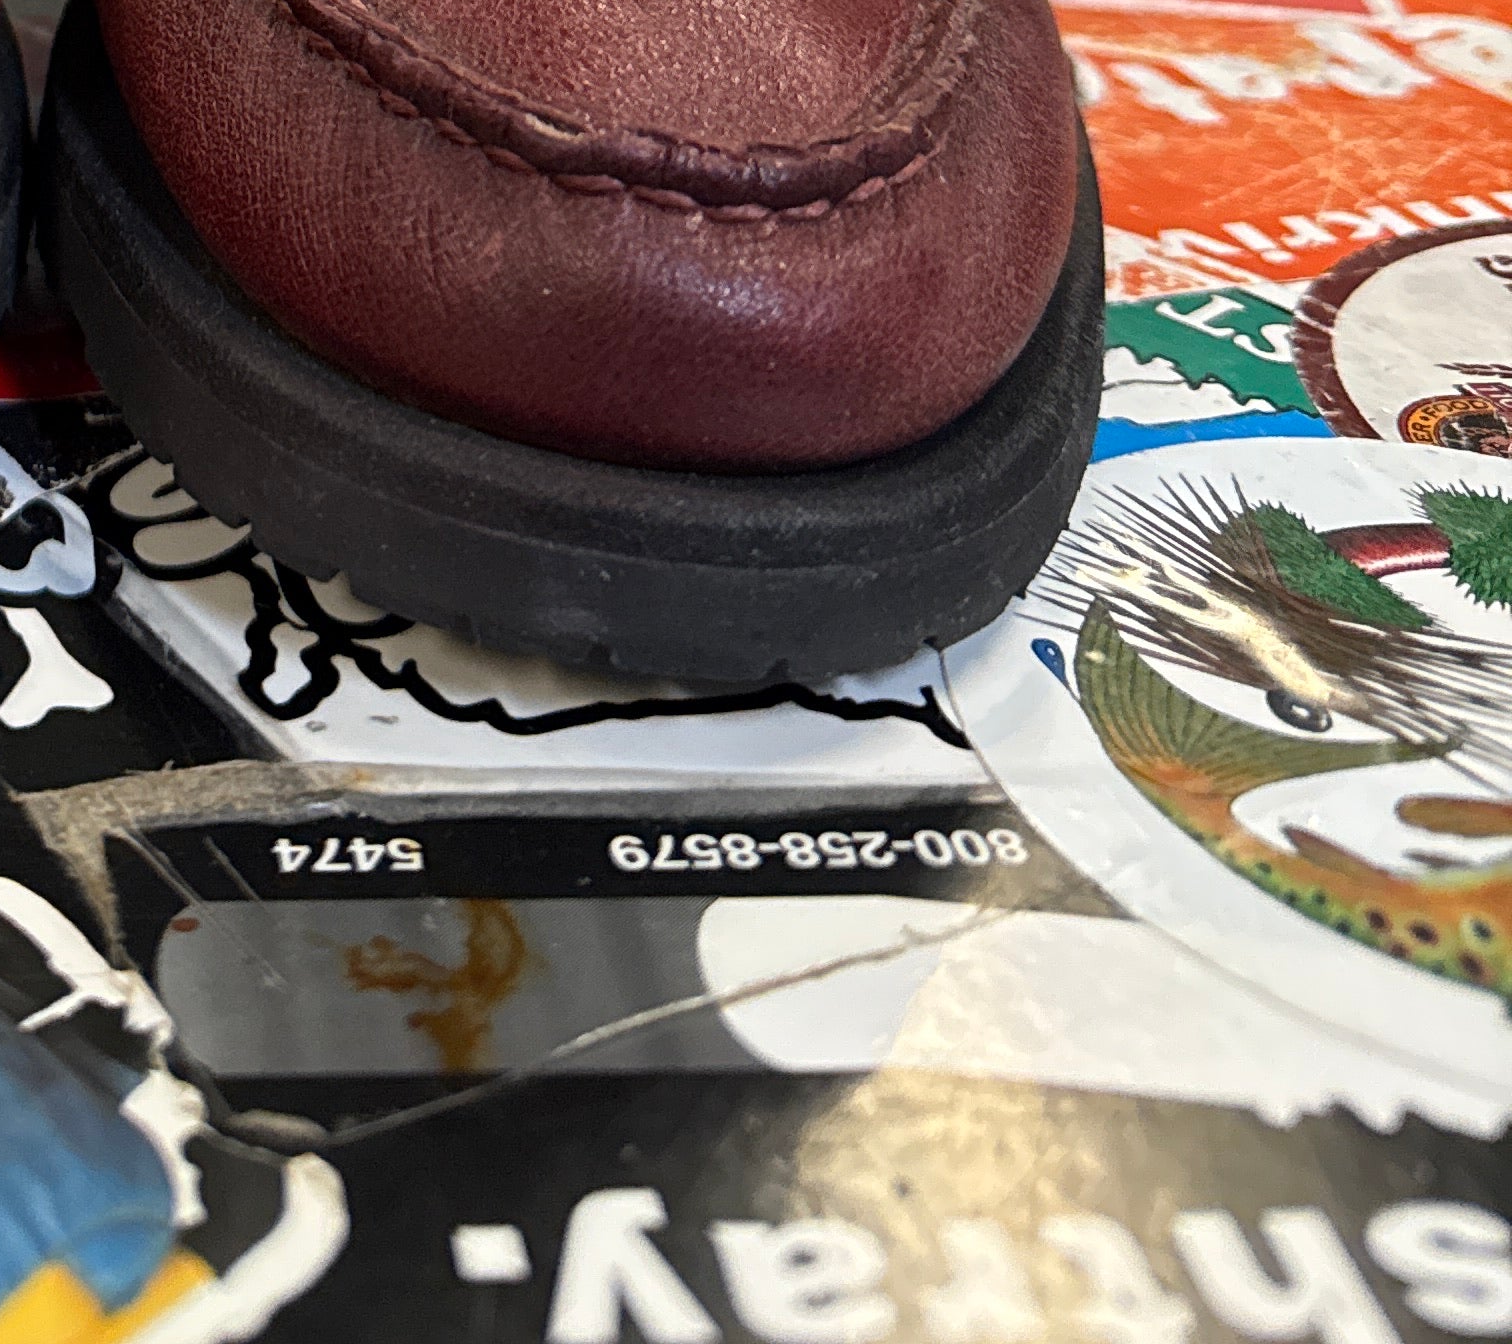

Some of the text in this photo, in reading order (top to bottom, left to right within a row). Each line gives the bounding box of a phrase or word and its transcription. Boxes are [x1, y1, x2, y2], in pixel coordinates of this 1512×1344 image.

[1428, 397, 1489, 419] FOOD
[272, 828, 1028, 873] 800-258-8579 5474
